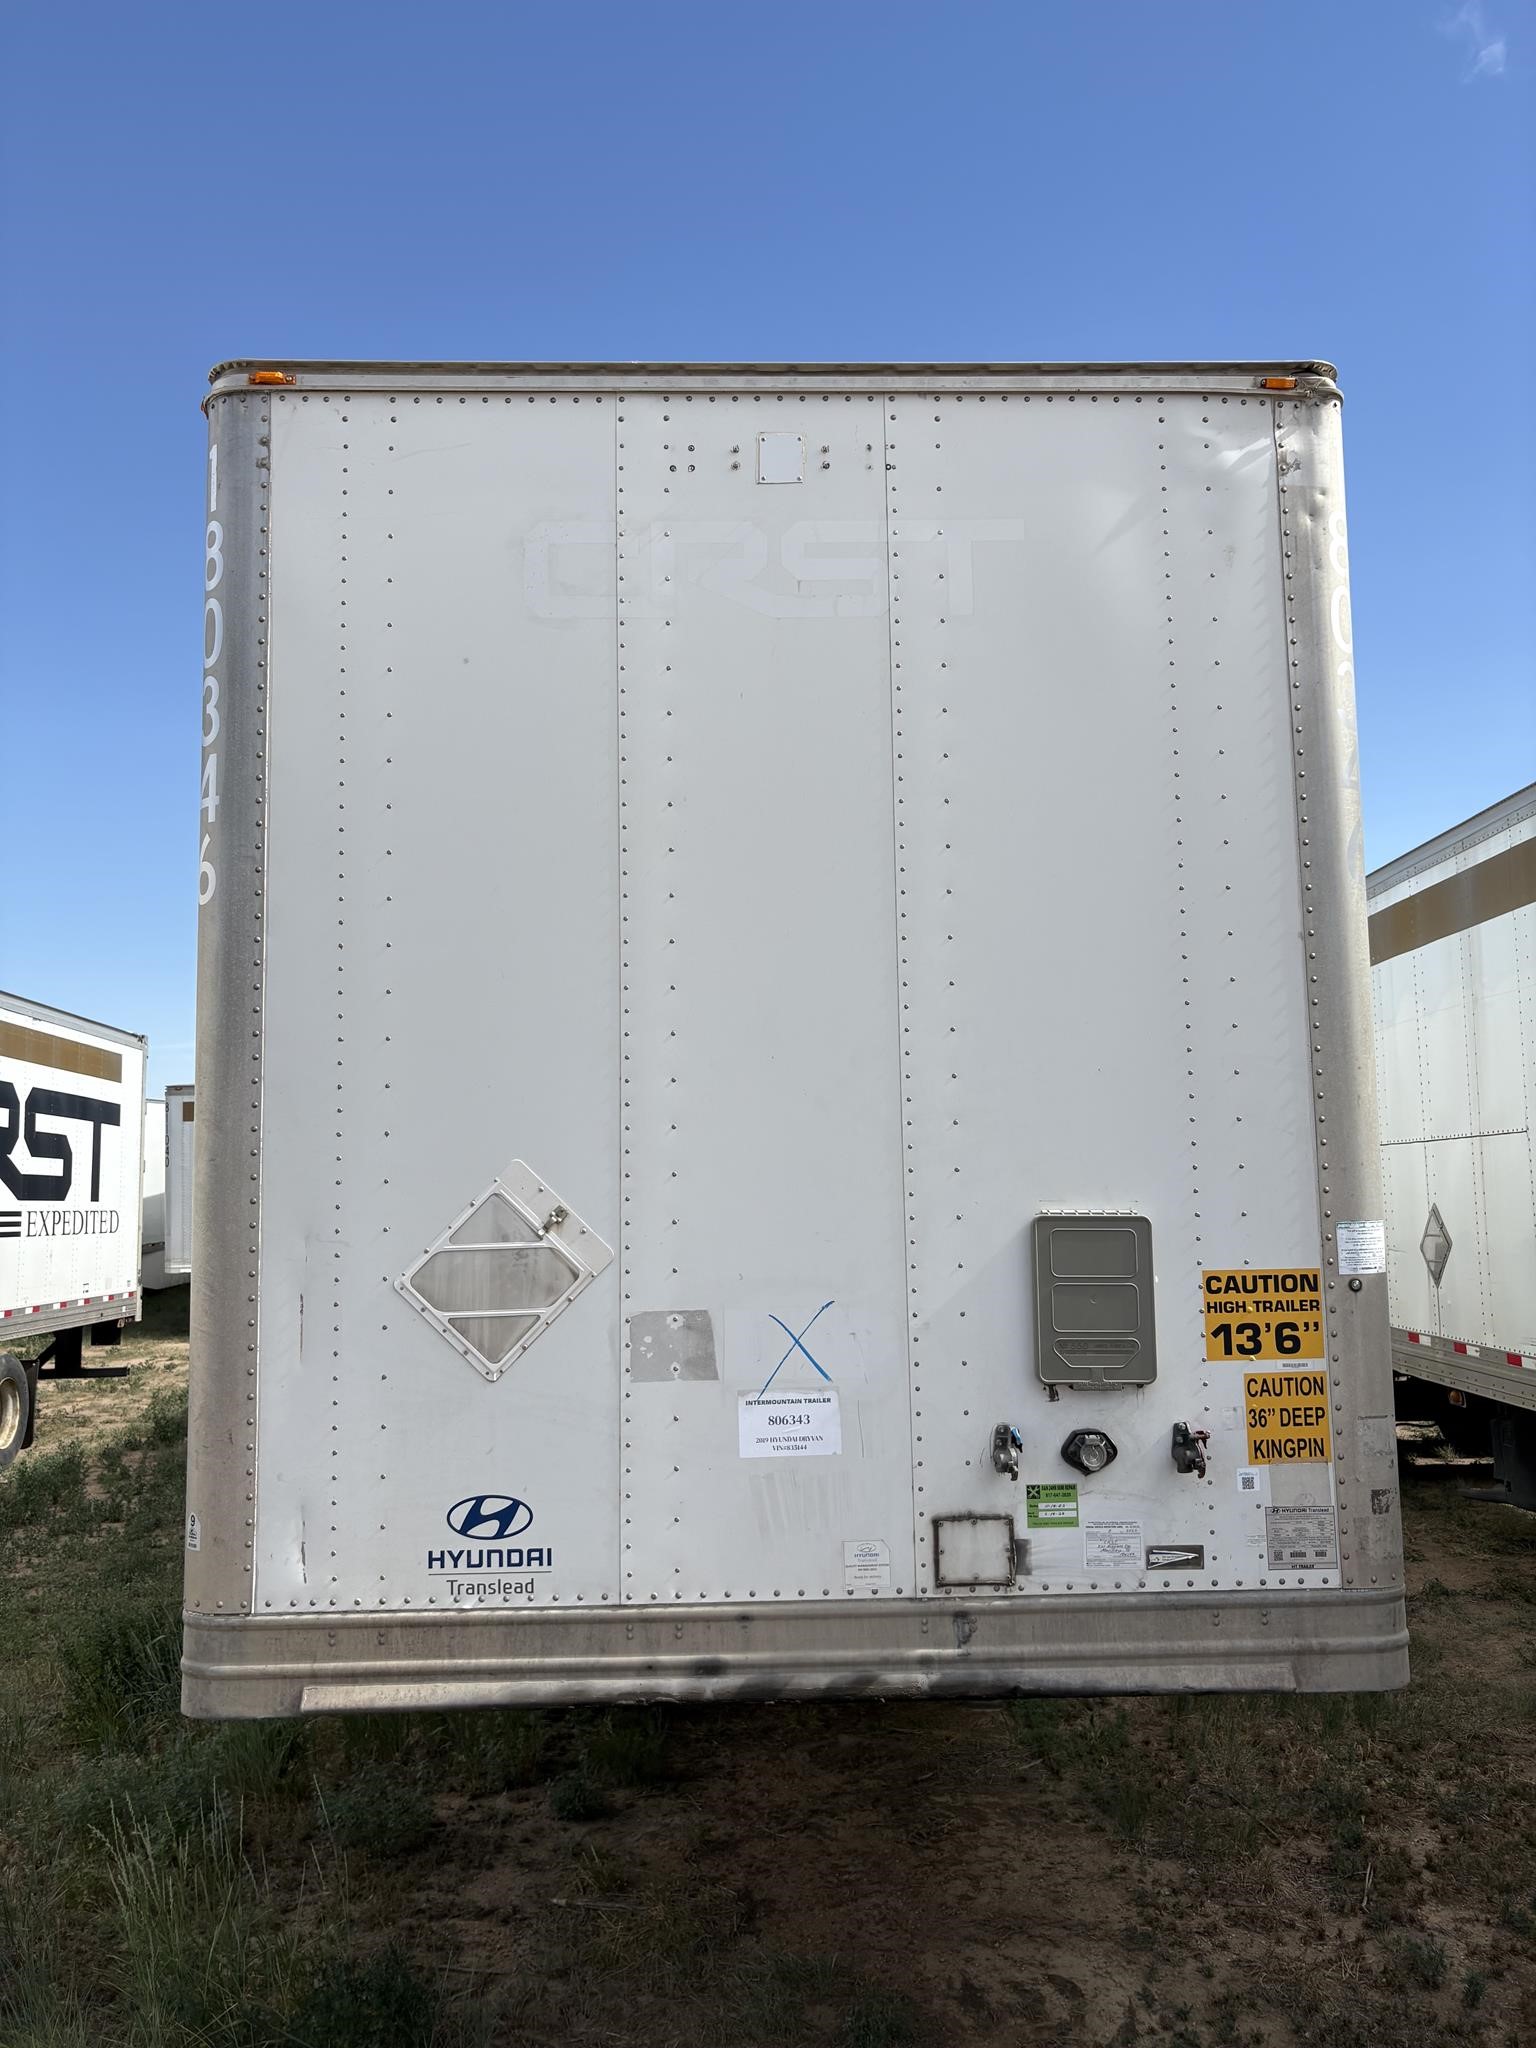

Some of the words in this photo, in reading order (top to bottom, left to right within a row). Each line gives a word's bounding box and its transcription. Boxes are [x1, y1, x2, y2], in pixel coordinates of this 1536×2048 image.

[26, 1209, 120, 1238] EXPEDITED
[1205, 1273, 1319, 1295] CAUTION
[1206, 1300, 1247, 1314] HIGH
[1252, 1299, 1320, 1313] TRAILER
[1246, 1376, 1325, 1398] CAUTION
[767, 1414, 811, 1426] 806343
[1279, 1406, 1326, 1427] DEEP
[1253, 1438, 1325, 1460] KINGPIN
[428, 1547, 553, 1569] HYUNDAI
[446, 1577, 535, 1596] Translead
